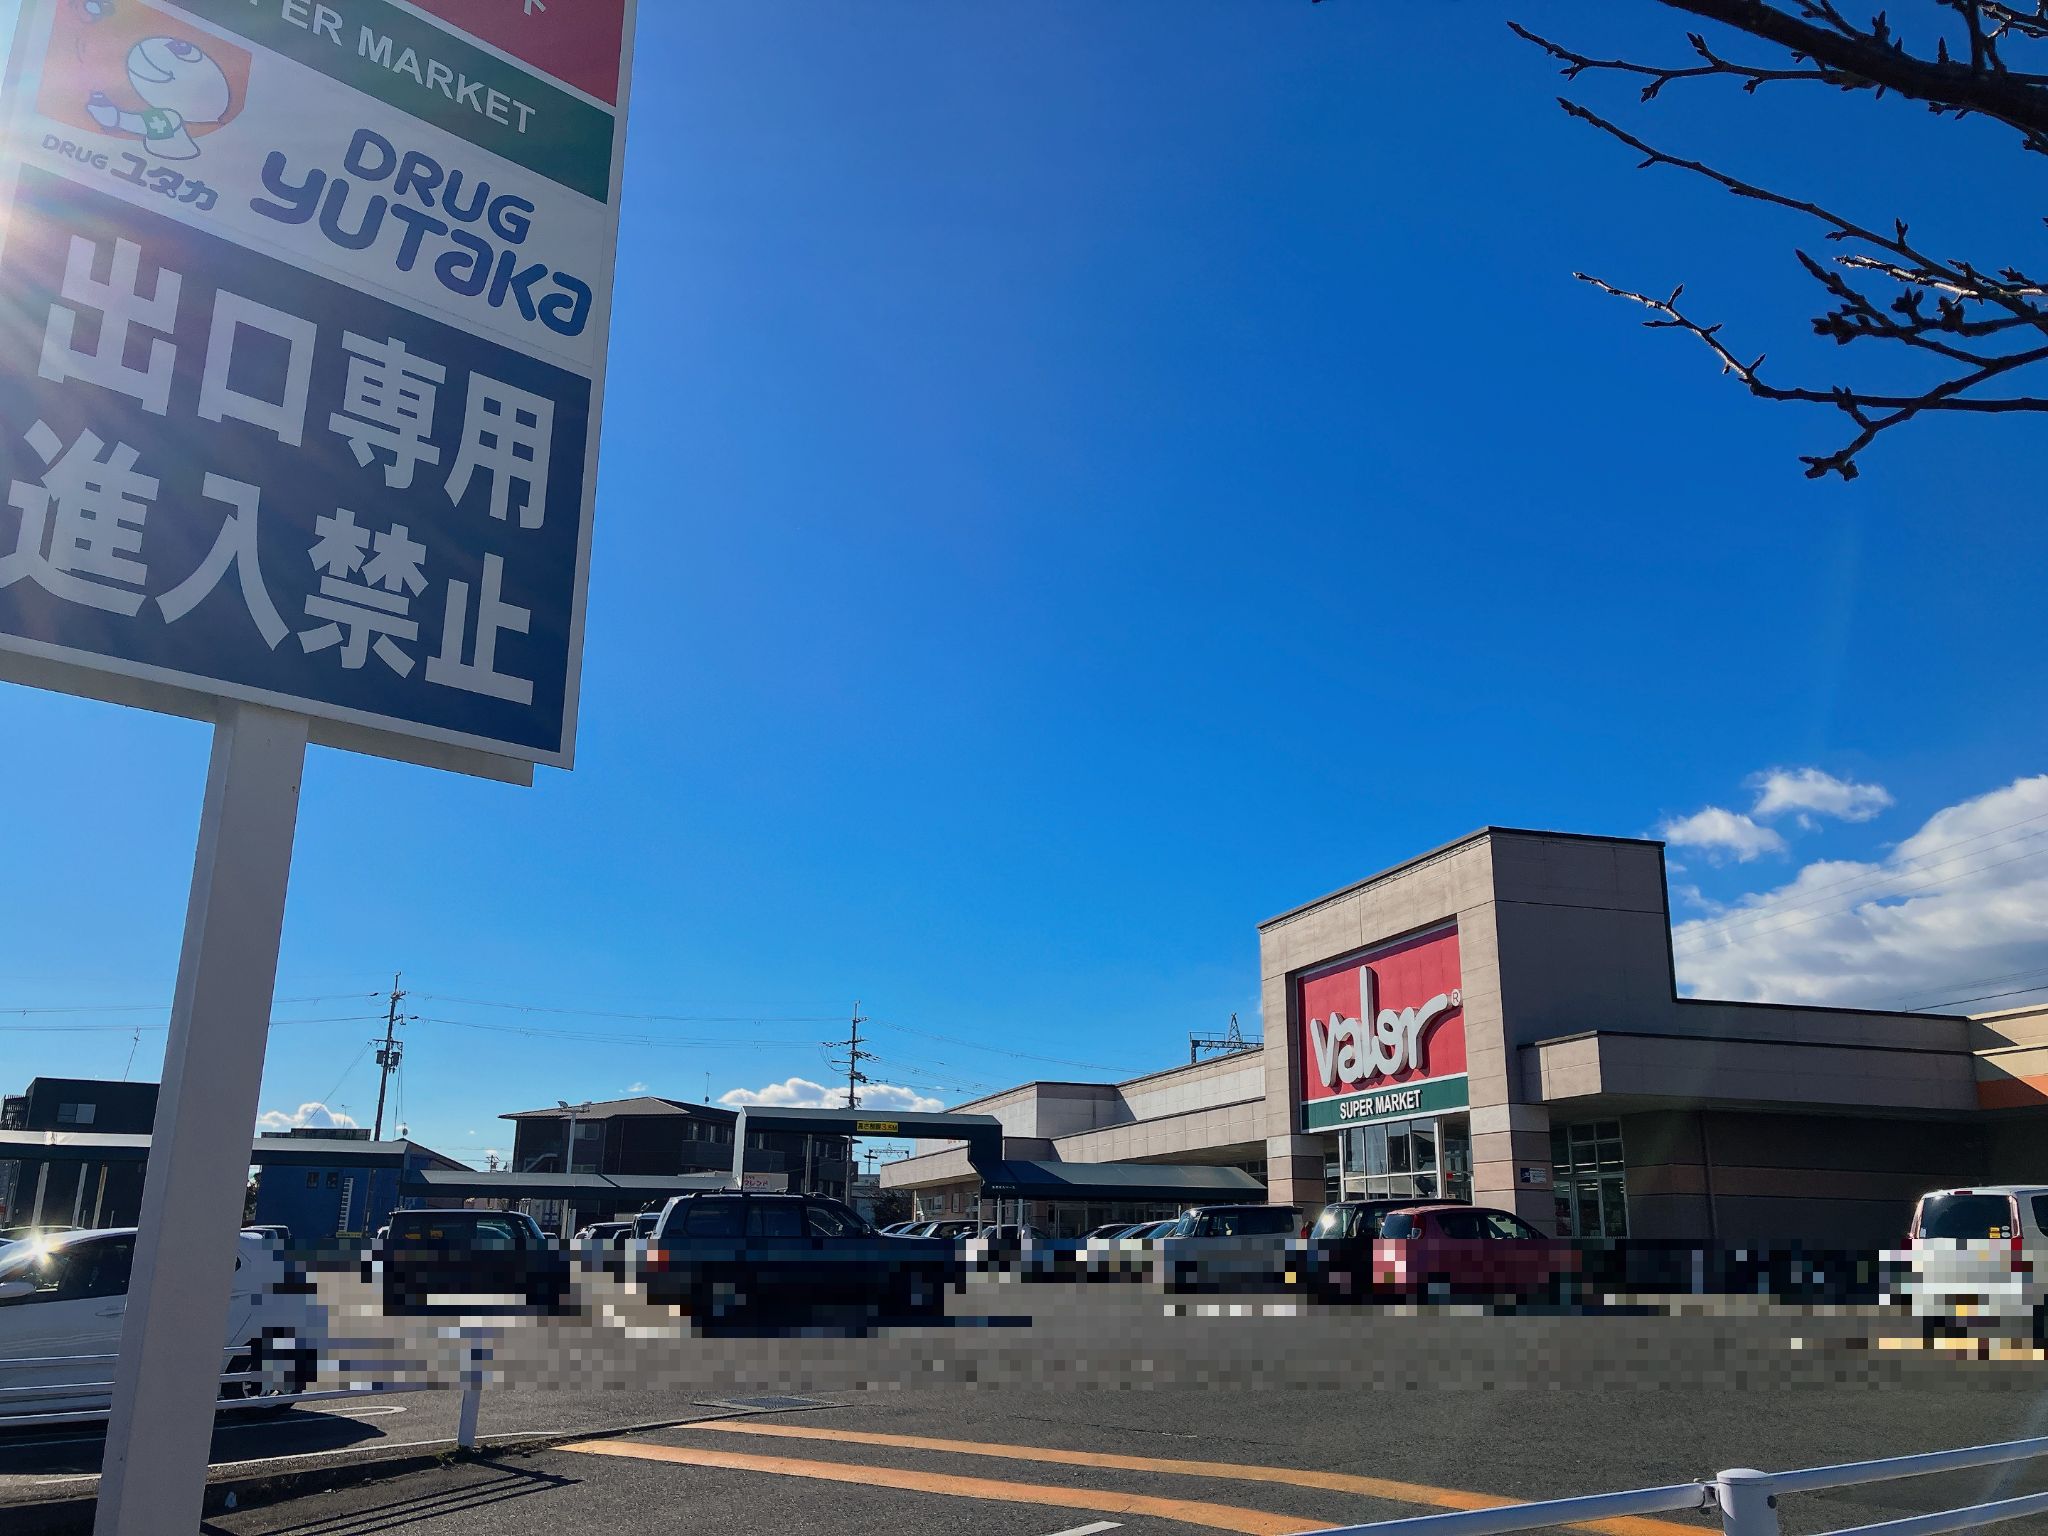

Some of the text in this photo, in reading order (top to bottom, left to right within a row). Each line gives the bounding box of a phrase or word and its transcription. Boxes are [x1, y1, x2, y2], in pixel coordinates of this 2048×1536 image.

[357, 25, 536, 133] MARKET
[42, 133, 219, 212] DRUG ユタカ
[343, 128, 535, 245] DRUG
[37, 234, 556, 529] 出口専用
[0, 418, 535, 706] 進入禁止
[1340, 1089, 1421, 1120] SUPER MARKET
